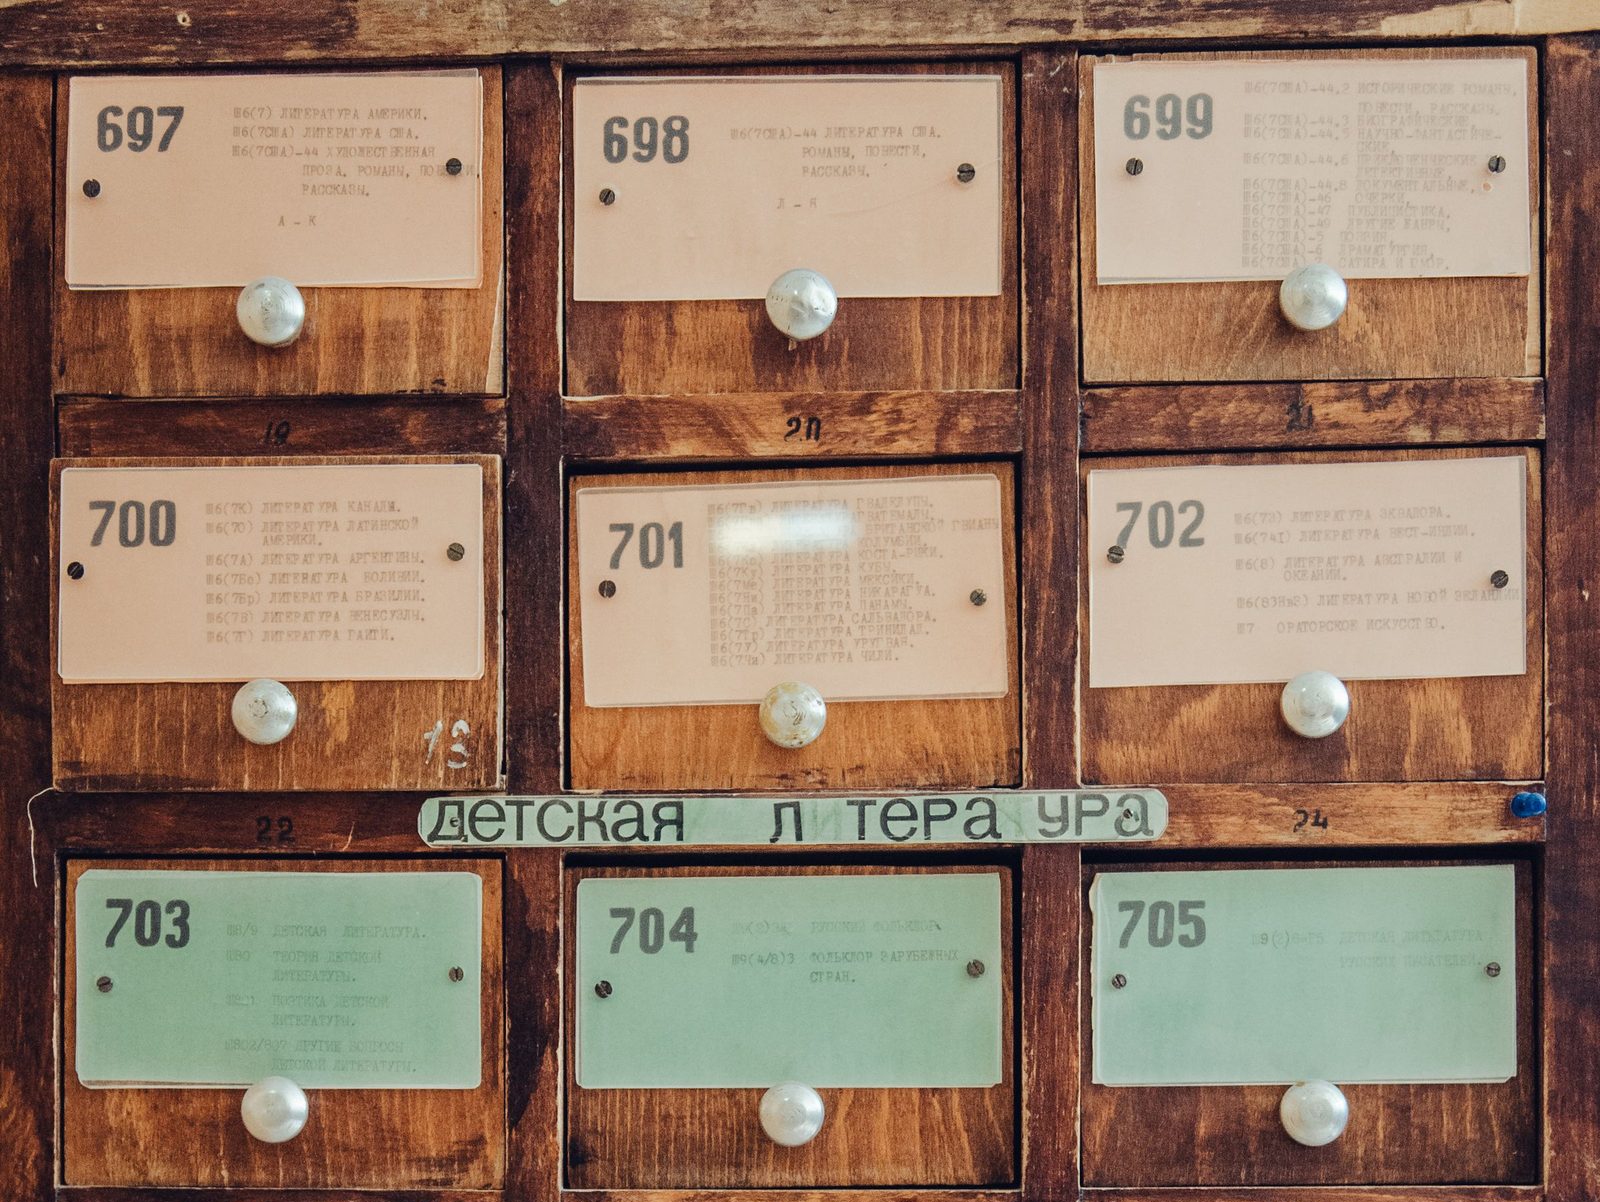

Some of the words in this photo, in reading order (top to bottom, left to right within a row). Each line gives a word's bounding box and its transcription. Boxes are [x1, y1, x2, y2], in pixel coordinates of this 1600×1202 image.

[280, 108, 359, 120] ЛИТЕРАТУРА
[368, 108, 428, 121] АМЕРИКИ.
[1124, 93, 1212, 140] 699
[98, 106, 184, 152] 697
[302, 127, 381, 139] ЛИТЕРАТУРА
[389, 127, 419, 139] США.
[824, 127, 903, 140] ЛИТЕРАТУРА
[912, 127, 941, 140] США.
[604, 116, 689, 163] 698
[326, 146, 435, 158] ХУДОЖЕСТВЕННАЯ
[302, 184, 370, 197] РАССКАЗЫ.
[261, 502, 338, 514] ЛИТЕРАТУРА
[89, 500, 176, 547] 700
[1116, 500, 1204, 547] 702
[1290, 510, 1372, 523] ЛИТЕРАТУРА
[609, 522, 683, 569] 701
[261, 553, 339, 565] ЛИТЕРАТУРА
[349, 551, 425, 564] АРГЕНТИНЫ.
[268, 591, 348, 604] ЛИТЕРАТУРА
[355, 589, 425, 603] БРАЗИЛИИ.
[765, 613, 844, 627] ЛИТЕРАТУРА
[1276, 620, 1359, 634] ОРАТОРСКОЕ
[1367, 617, 1446, 631] ИСКУССТВО.
[261, 630, 339, 643] ЛИТЕРАТУРА
[773, 652, 853, 665] ЛИТЕРАТУРА
[427, 800, 684, 842] детская
[1292, 809, 1328, 834] 24
[256, 816, 296, 842] 22
[106, 899, 189, 948] 703
[610, 907, 697, 954] 704
[1119, 901, 1206, 948] 705
[272, 925, 328, 938] ДЕТСКАЯ
[342, 925, 427, 938] ЛИТЕРАТУРА.
[810, 971, 856, 983] СТРАН.
